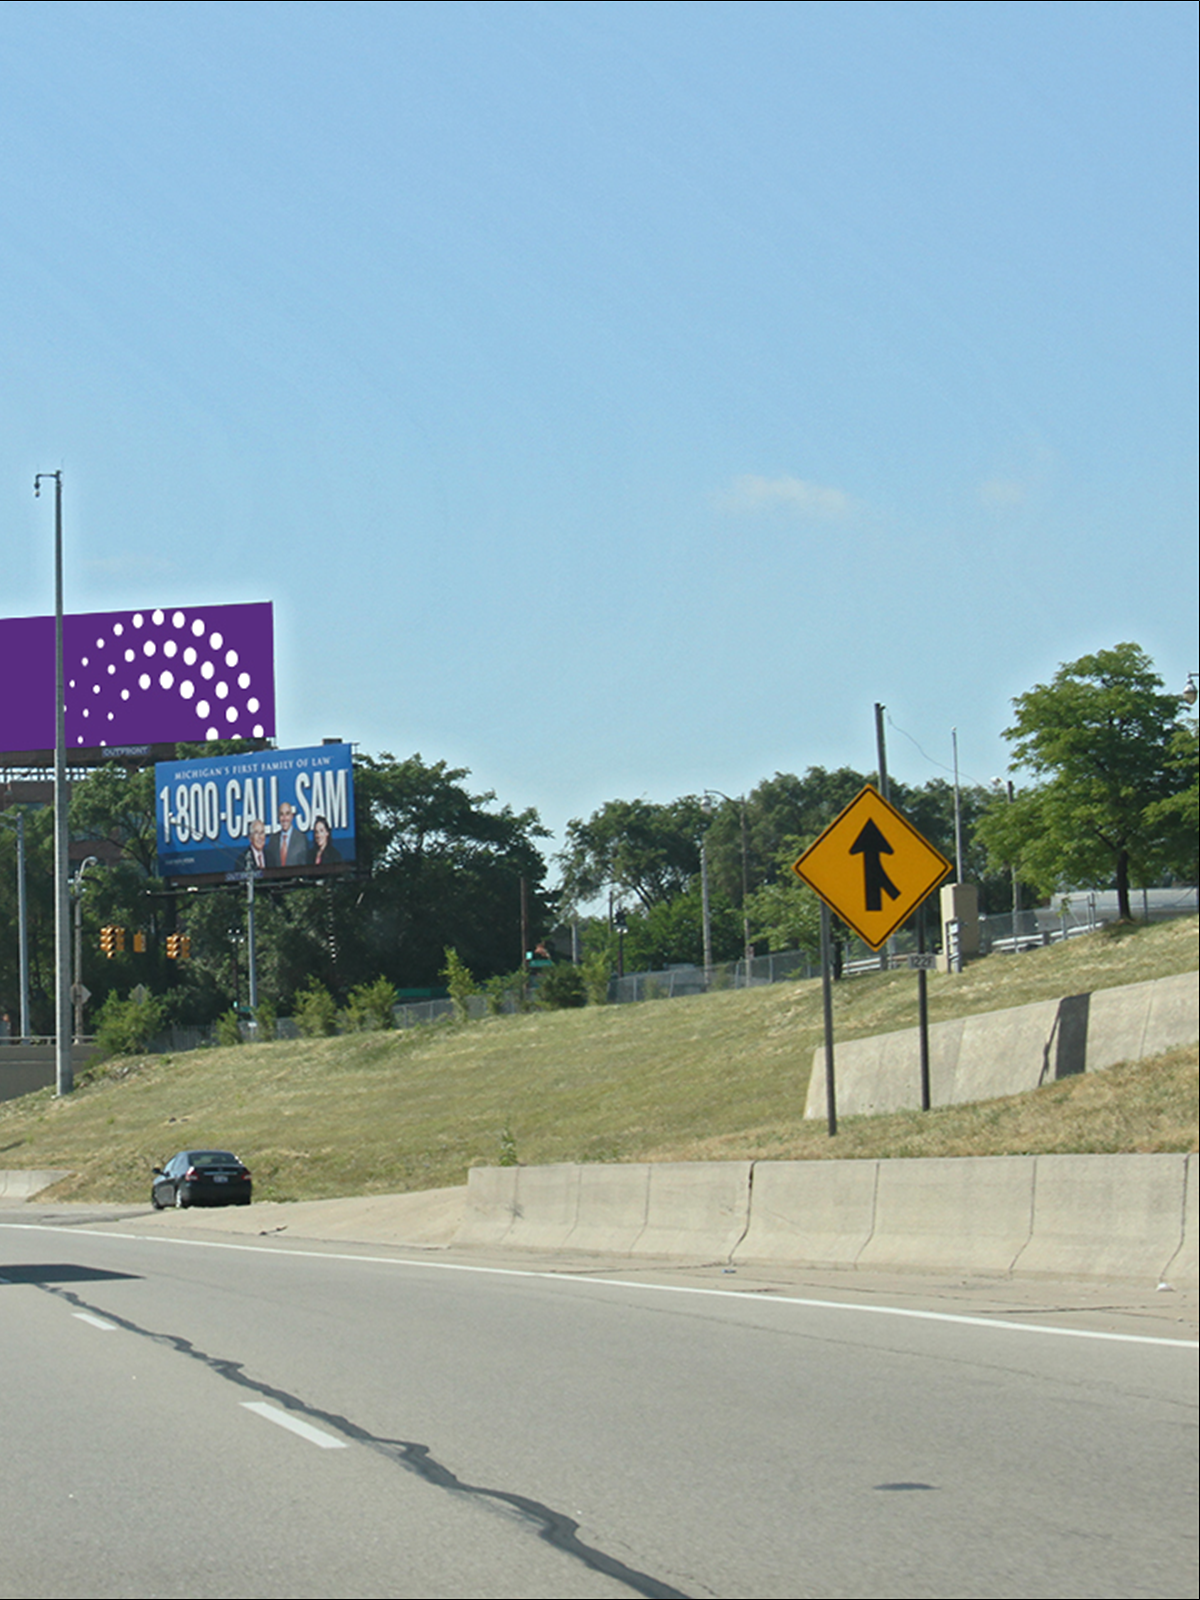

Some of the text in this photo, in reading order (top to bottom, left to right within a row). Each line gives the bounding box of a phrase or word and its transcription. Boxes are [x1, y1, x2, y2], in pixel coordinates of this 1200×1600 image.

[174, 767, 230, 780] MICHIGAN'S
[232, 764, 258, 775] FIRST
[261, 760, 294, 772] FAMILY
[296, 758, 309, 768] OF
